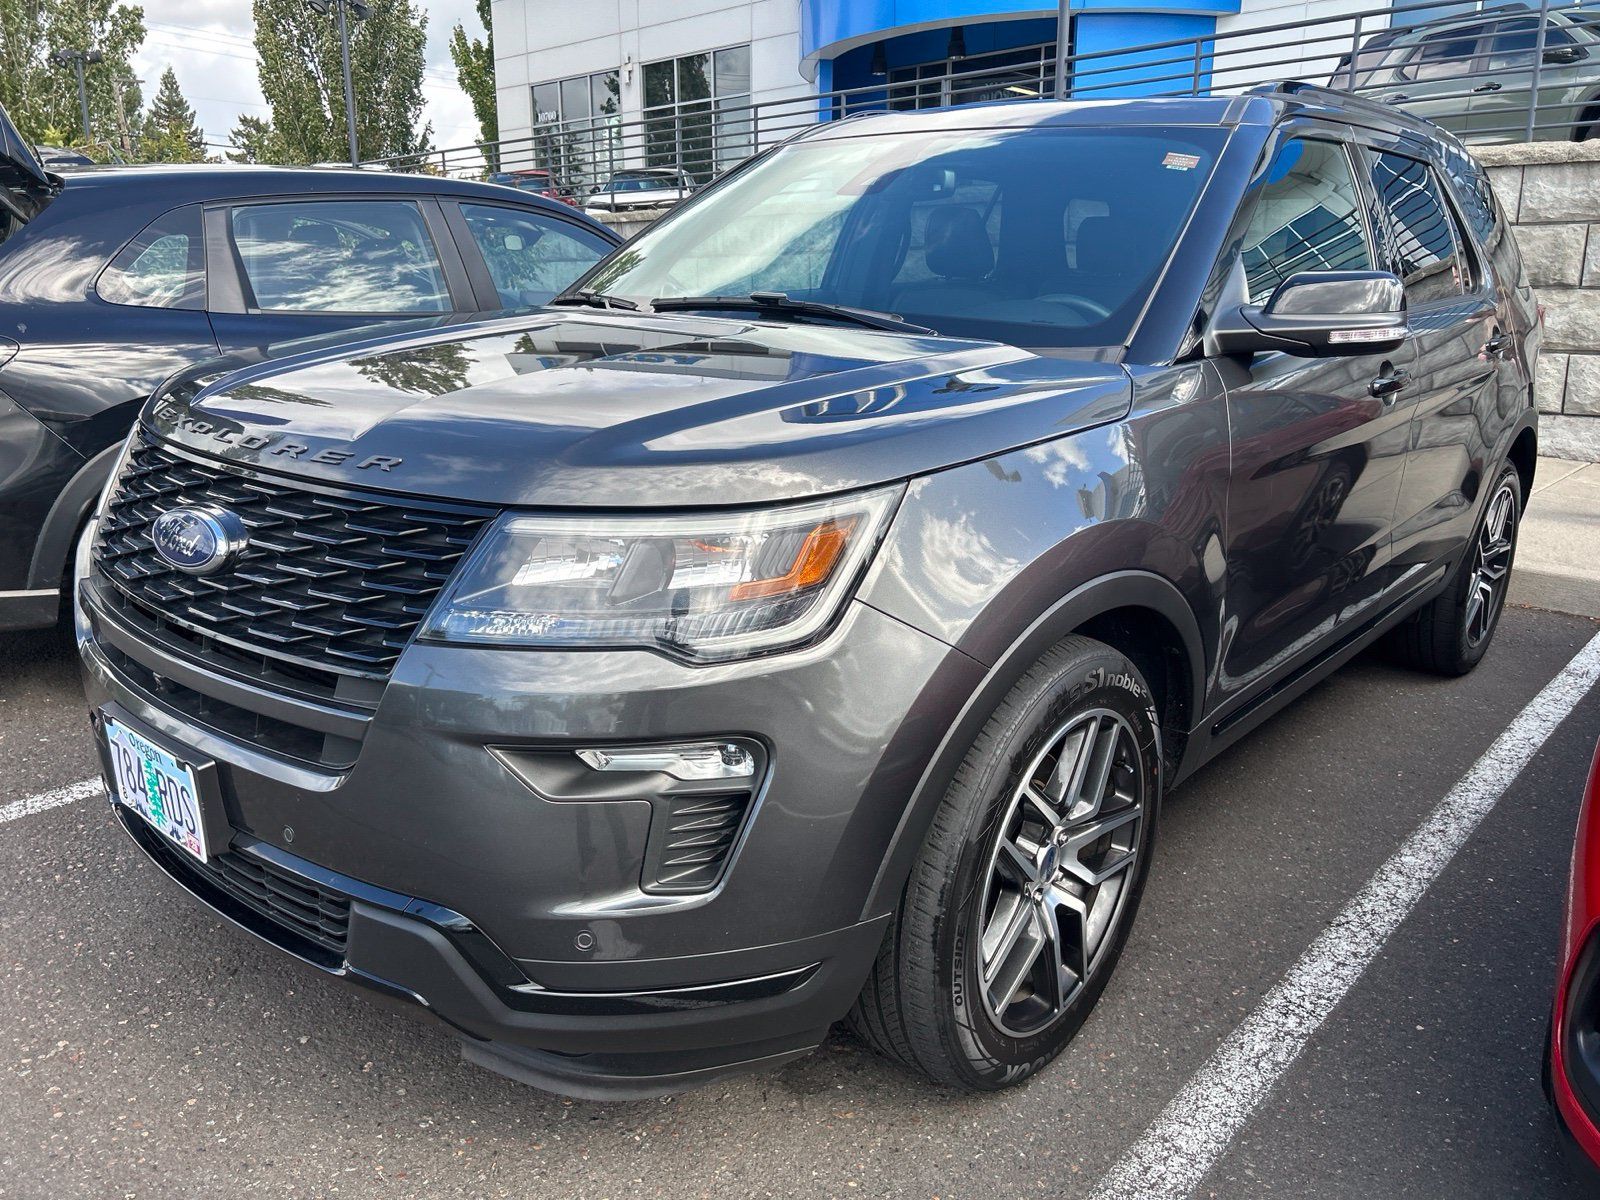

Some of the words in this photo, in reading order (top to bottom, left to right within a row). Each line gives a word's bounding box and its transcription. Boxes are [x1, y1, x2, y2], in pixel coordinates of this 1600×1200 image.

[158, 406, 403, 472] EXPLORER
[160, 516, 201, 557] Ford
[1081, 667, 1105, 694] S1
[128, 732, 163, 766] Oregon
[110, 739, 149, 803] 784
[155, 768, 196, 835] RDS
[953, 924, 966, 1007] OUTSIDE
